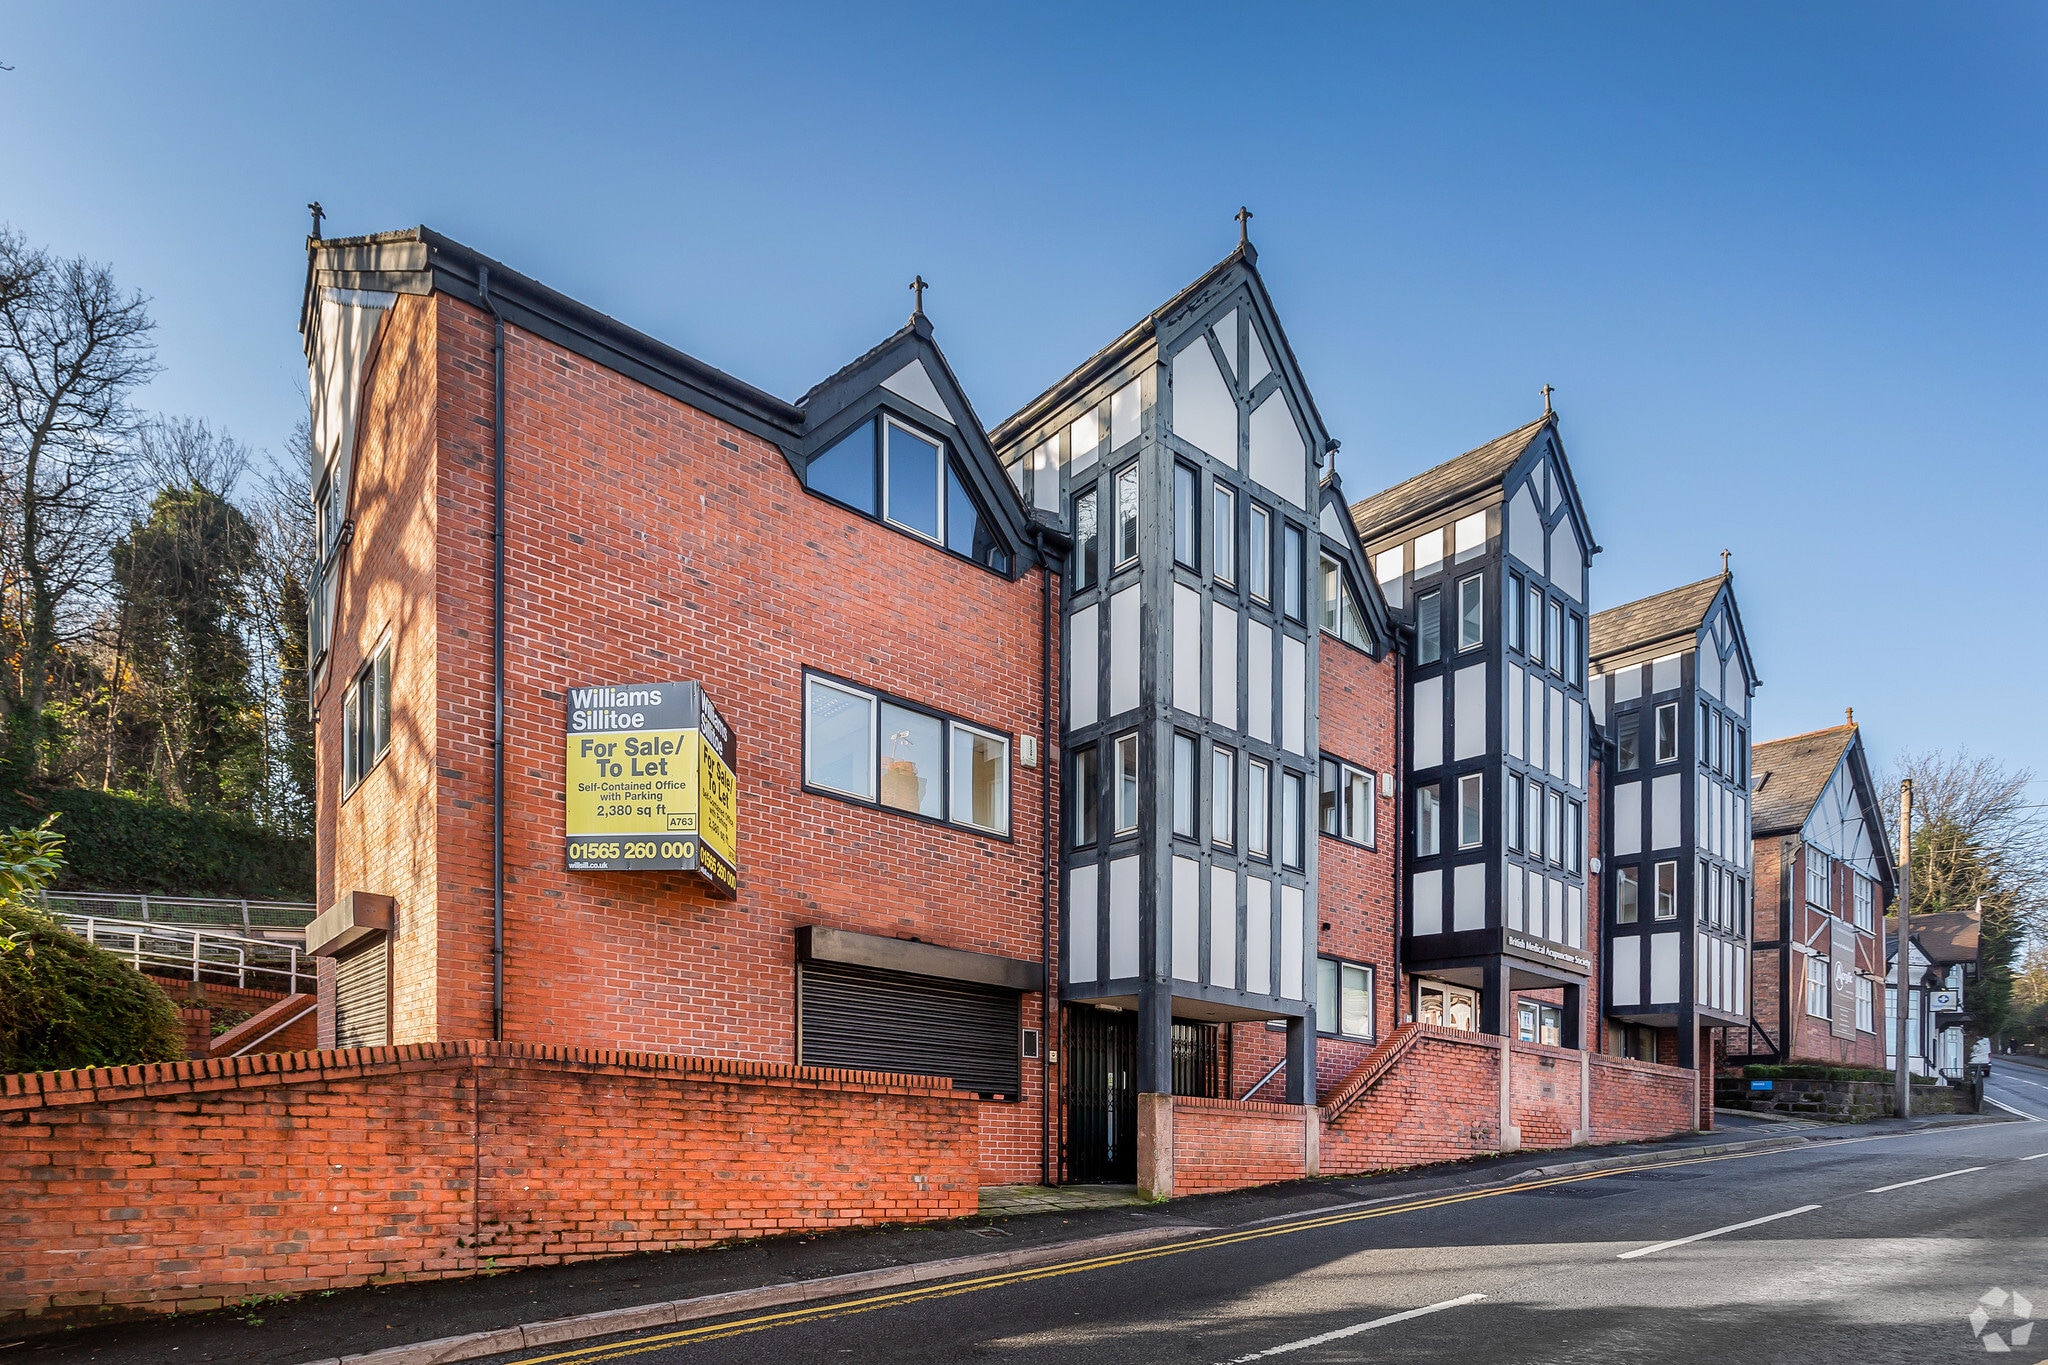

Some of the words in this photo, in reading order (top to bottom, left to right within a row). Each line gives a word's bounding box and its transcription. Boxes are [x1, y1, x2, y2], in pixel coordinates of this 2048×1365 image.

[572, 688, 662, 709] Williams
[572, 710, 645, 731] Sillitoe
[701, 689, 728, 742] Williams
[581, 739, 617, 758] For
[624, 735, 685, 757] Sale/
[596, 758, 623, 778] To
[631, 757, 668, 777] Let
[703, 744, 715, 773] For
[716, 761, 734, 795] Sale/
[578, 781, 652, 792] Self-Contained
[655, 780, 686, 790] Office
[708, 770, 717, 795] To
[718, 782, 729, 810] Let
[600, 791, 621, 801] with
[624, 791, 663, 803] Parking
[597, 804, 633, 818] 2,380
[636, 806, 652, 817] sq
[656, 804, 666, 815] ft
[670, 817, 693, 827] A763
[569, 842, 620, 860] 01565
[624, 841, 656, 859] 260
[661, 841, 695, 859] 000
[700, 846, 717, 874] 01565
[716, 861, 727, 883] 260
[727, 870, 737, 891] 000
[1508, 935, 1526, 949] British
[1526, 940, 1545, 955] Medical
[1545, 947, 1575, 963] Acupuncture
[1574, 955, 1591, 970] Society
